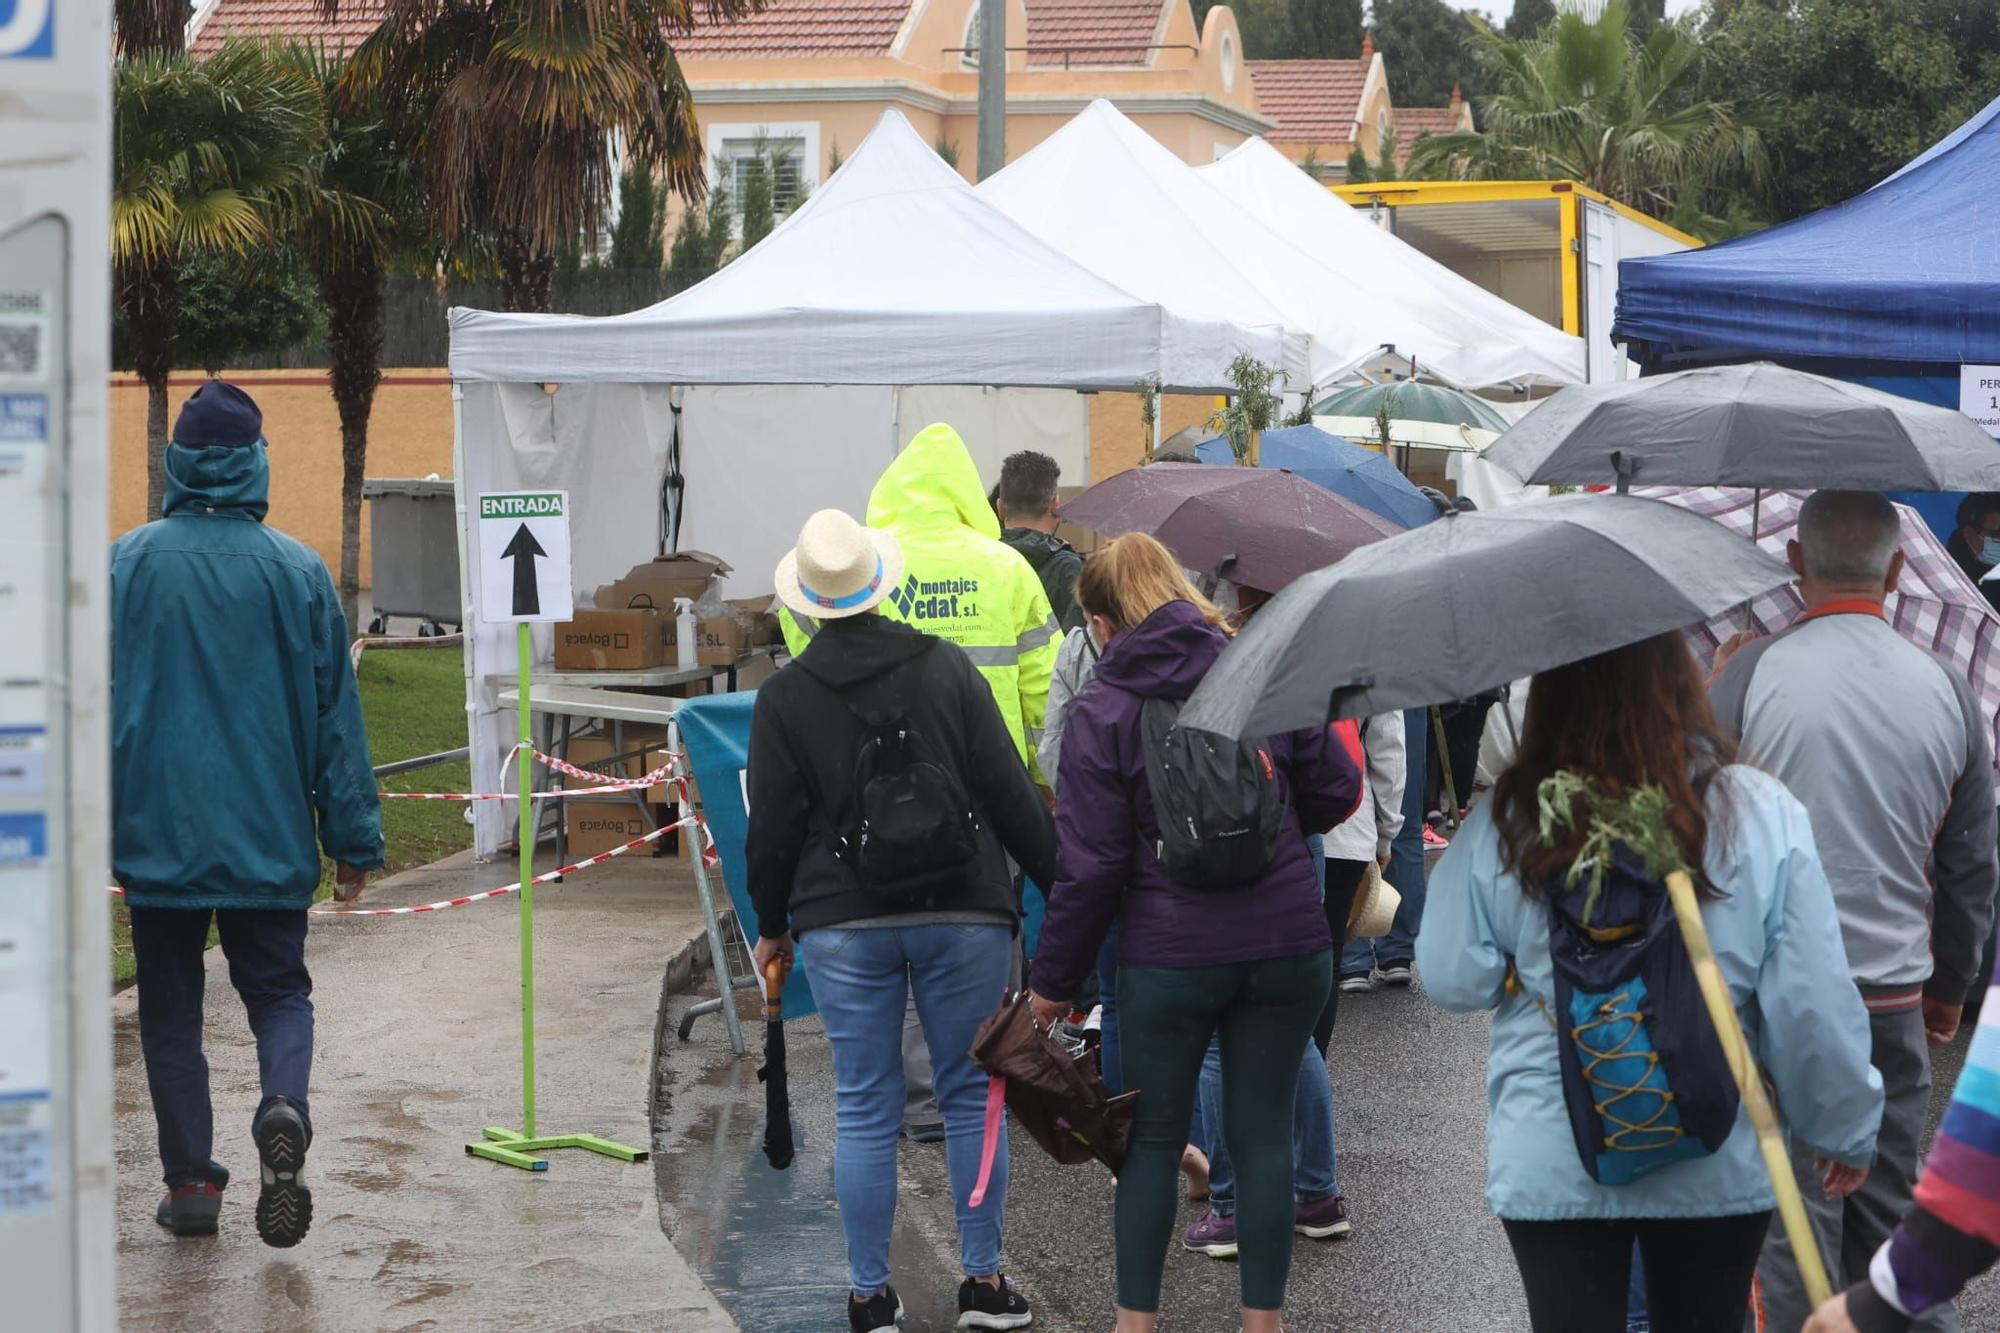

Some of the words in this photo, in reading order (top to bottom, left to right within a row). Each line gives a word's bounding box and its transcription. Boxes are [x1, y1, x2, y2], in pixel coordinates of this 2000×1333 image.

[482, 497, 563, 515] ENTRADA
[920, 577, 979, 596] montajes
[963, 603, 979, 617] s.l.
[565, 632, 610, 647] Boyacá
[706, 633, 726, 647] S.L.
[579, 820, 624, 834] Boyacá
